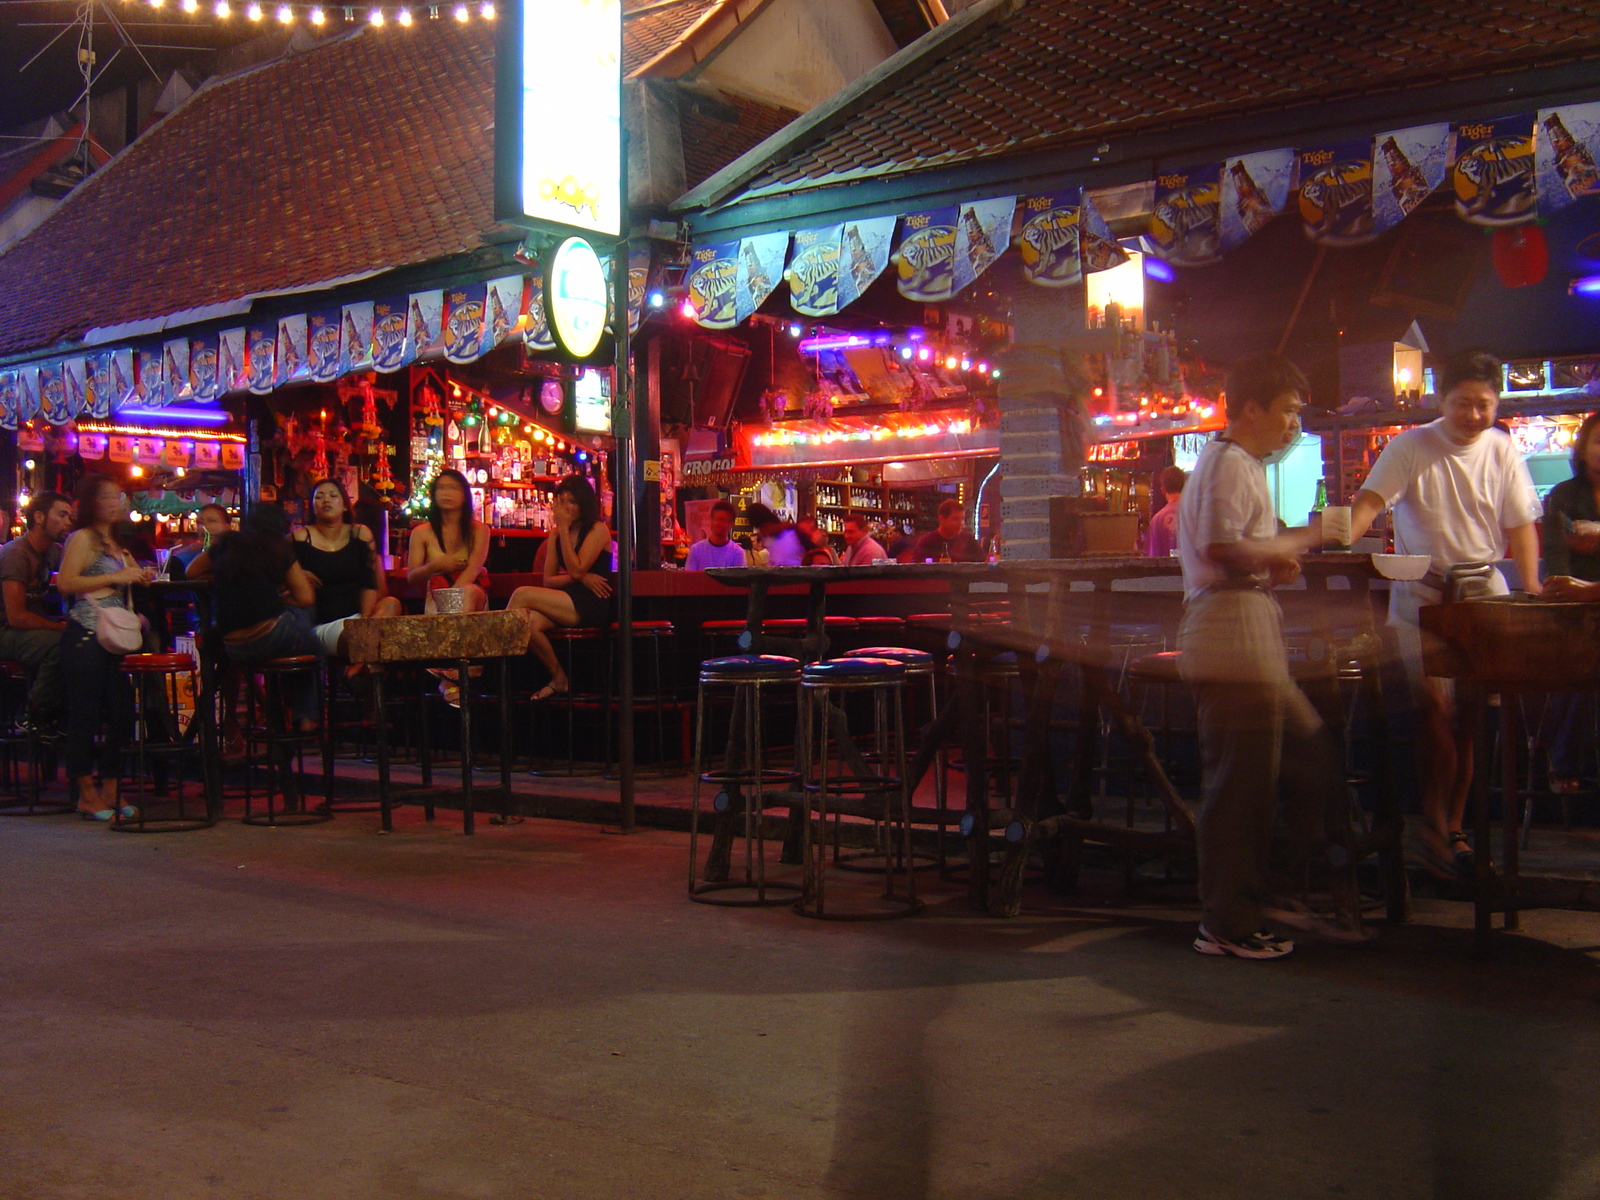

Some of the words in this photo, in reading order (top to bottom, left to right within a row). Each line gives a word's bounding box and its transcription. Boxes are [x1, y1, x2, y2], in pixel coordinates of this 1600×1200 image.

[1459, 124, 1494, 140] Tiger
[1302, 150, 1335, 166] Tiger
[1158, 174, 1188, 188] Tiger
[1027, 197, 1053, 211] Tiger
[906, 214, 931, 228] Tiger
[796, 231, 819, 245] Tiger
[694, 248, 717, 263] Tiger
[738, 498, 746, 511] 4
